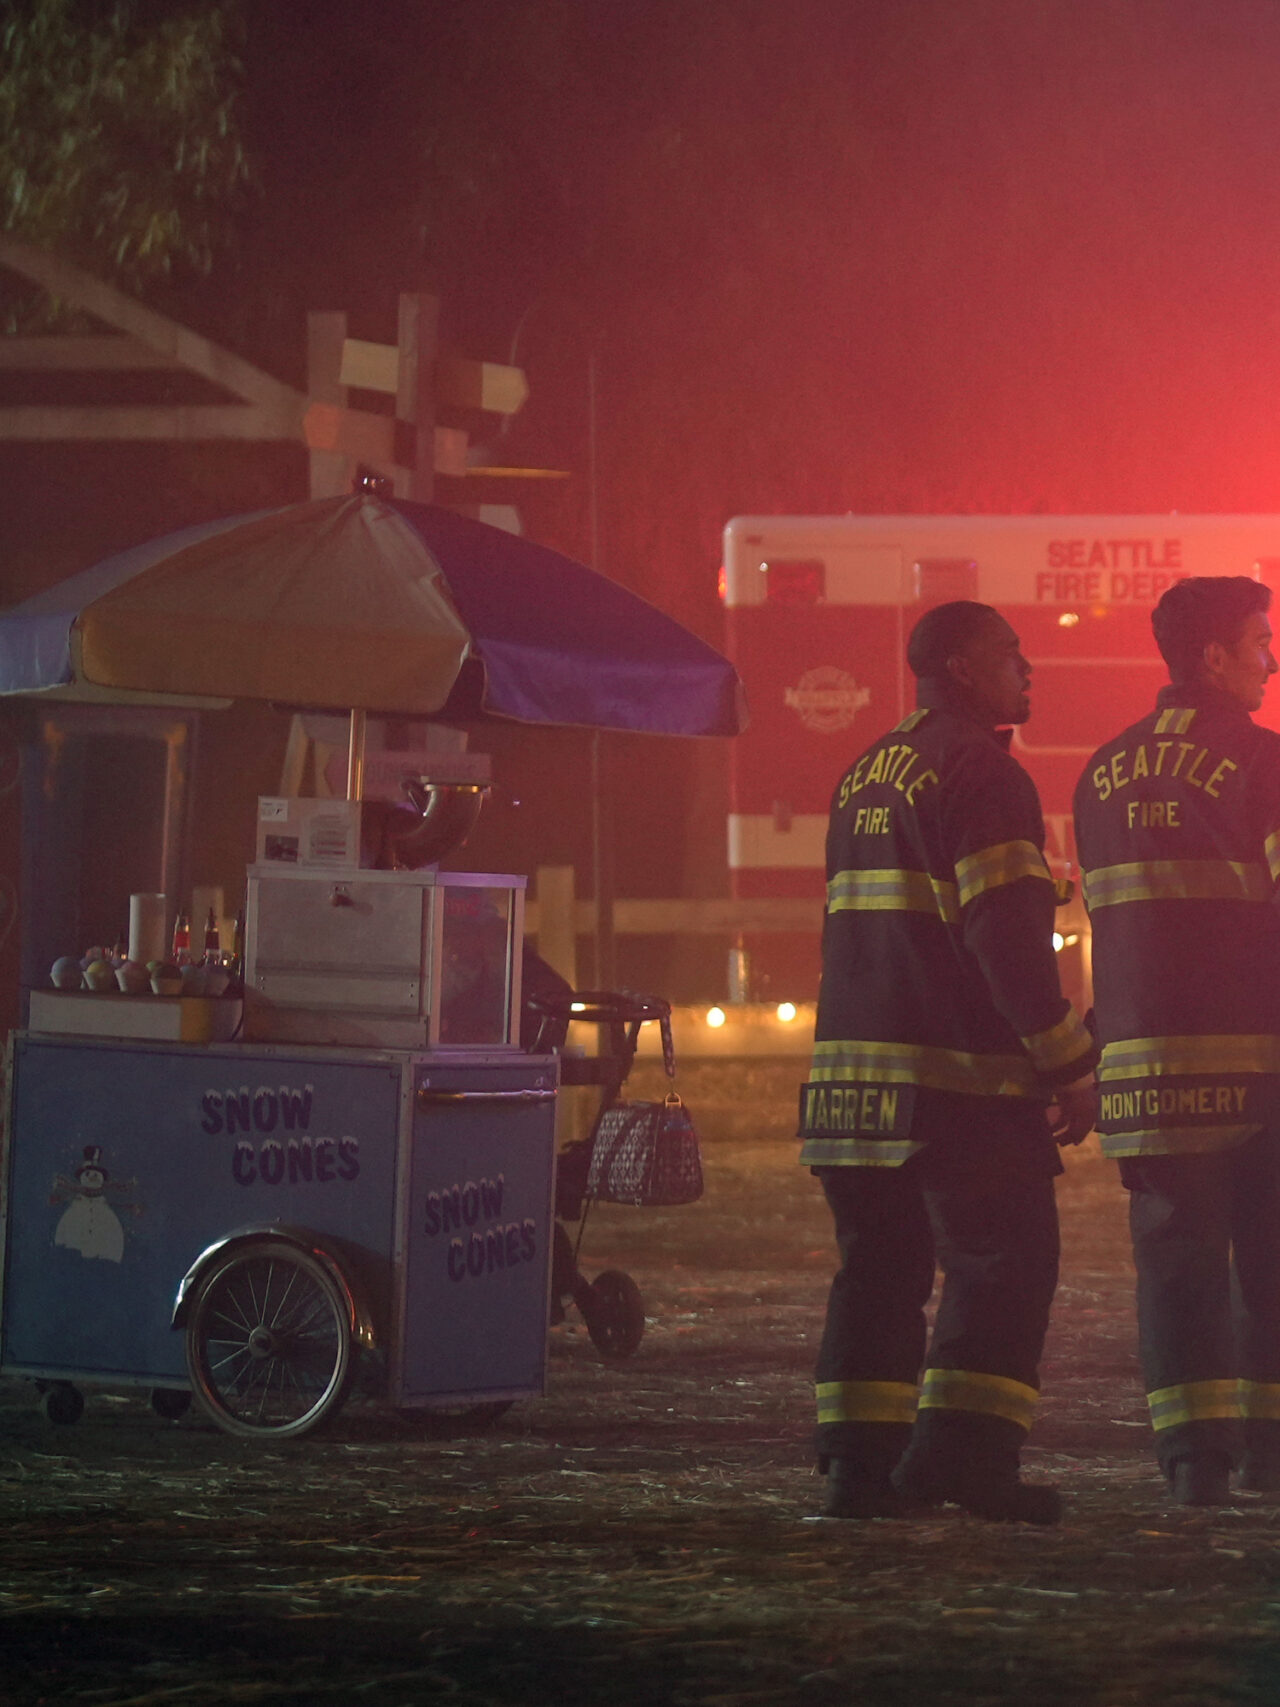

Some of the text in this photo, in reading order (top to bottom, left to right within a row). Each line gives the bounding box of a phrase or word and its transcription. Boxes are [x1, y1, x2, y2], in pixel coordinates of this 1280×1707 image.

[1048, 539, 1182, 568] SEATTLE
[1036, 572, 1191, 601] FIRE DEP
[837, 744, 939, 809] SEATTLE
[1092, 741, 1238, 801] SEATTLE
[853, 806, 891, 835] FIRE
[1127, 801, 1181, 829] FIRE
[201, 1083, 314, 1136] SNOW
[1101, 1086, 1248, 1121] MONTGOMERY
[231, 1136, 361, 1186] CONES
[424, 1172, 505, 1237] SNOW
[447, 1217, 537, 1282] CONES
